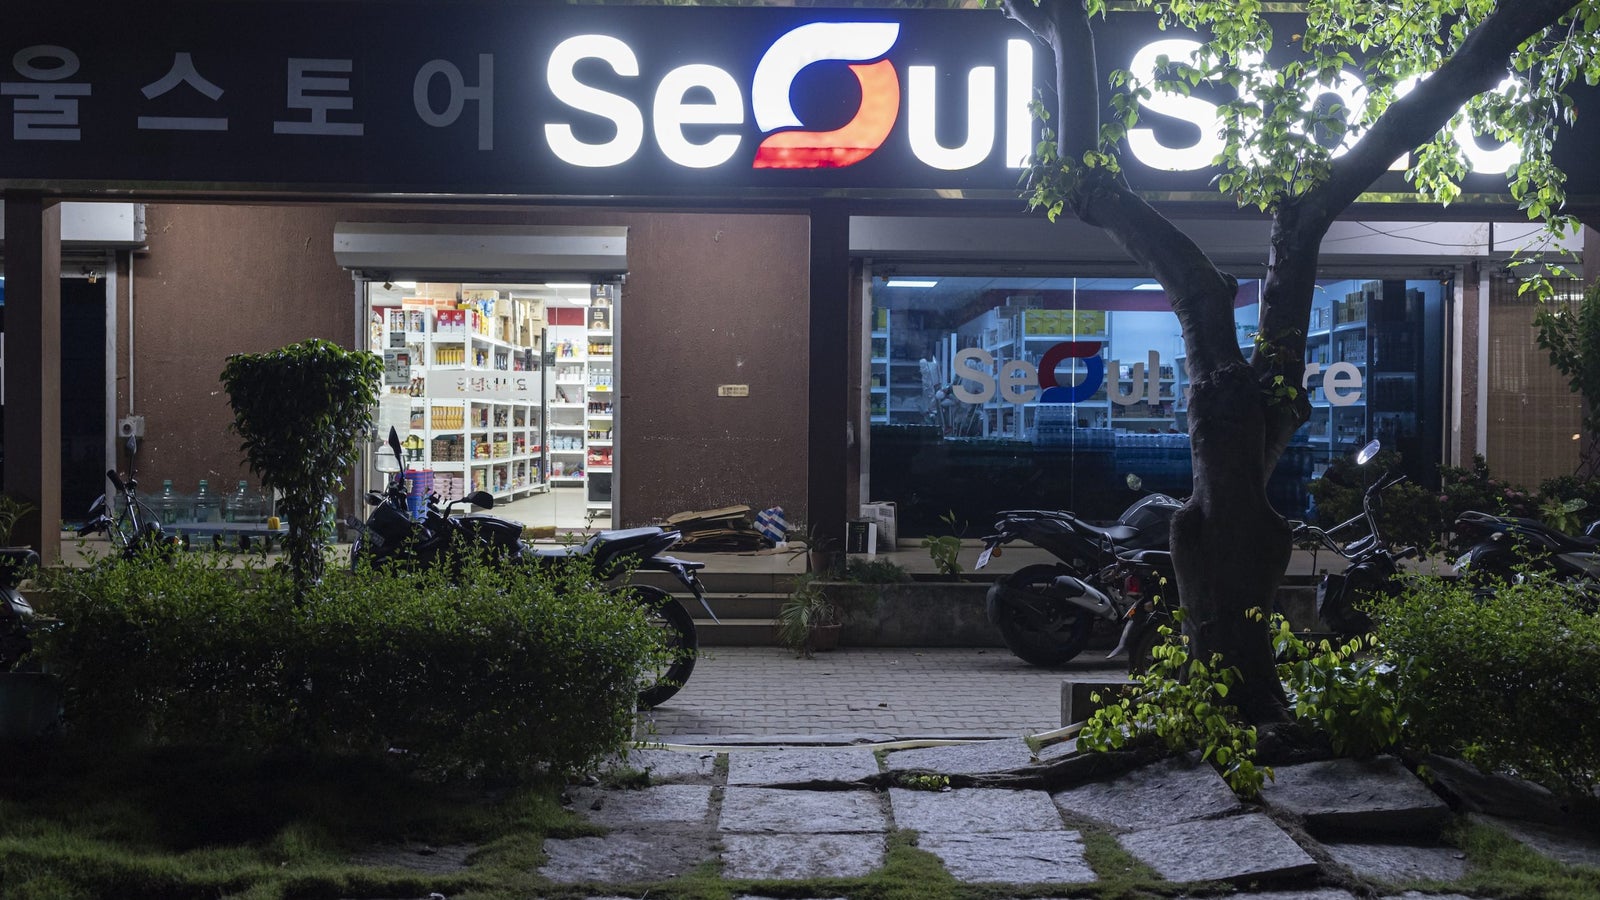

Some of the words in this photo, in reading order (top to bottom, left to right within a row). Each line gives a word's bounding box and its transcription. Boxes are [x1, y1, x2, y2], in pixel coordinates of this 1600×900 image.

[544, 22, 1034, 170] Seoul
[1127, 38, 1533, 175] Stoe
[952, 341, 1161, 406] Seoul
